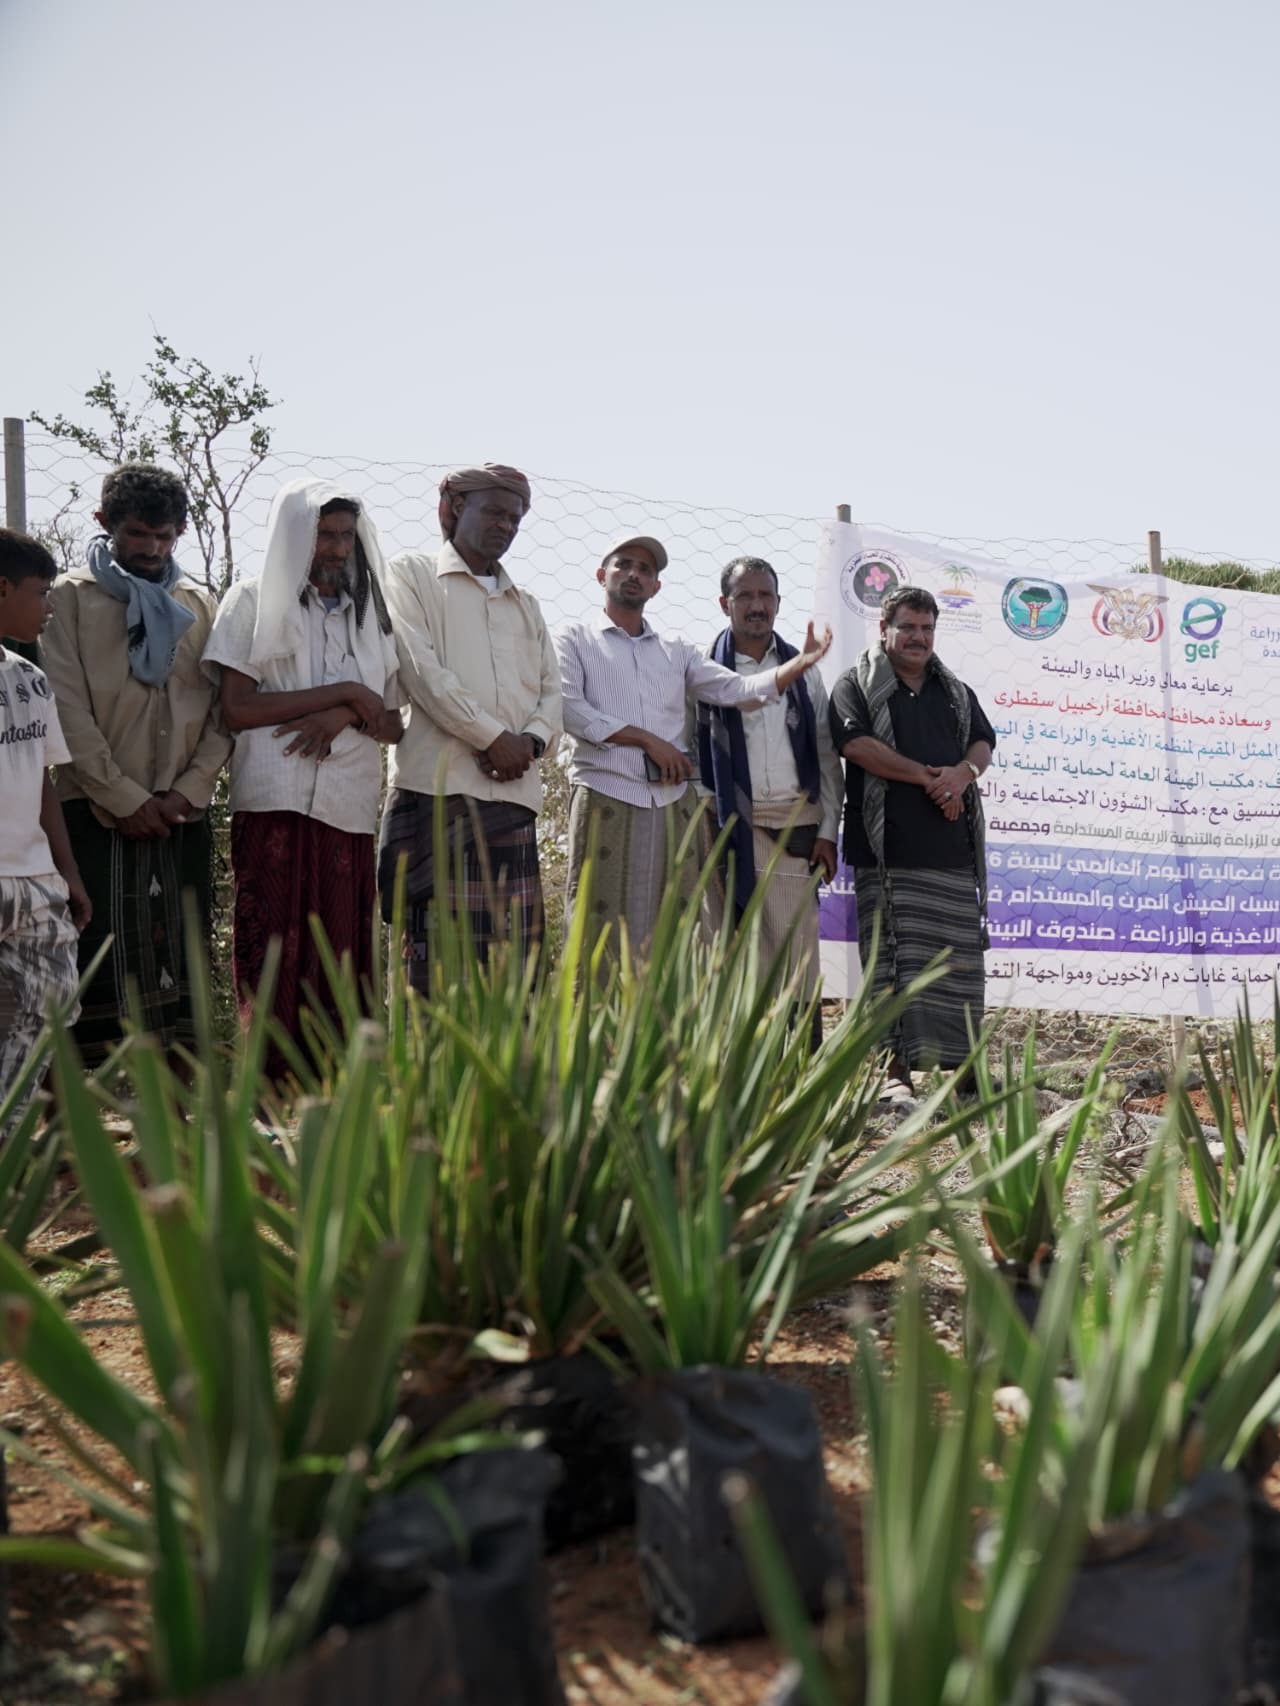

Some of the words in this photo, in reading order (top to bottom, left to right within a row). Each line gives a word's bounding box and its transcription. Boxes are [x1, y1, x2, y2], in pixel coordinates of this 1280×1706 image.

[1184, 640, 1220, 663] gef
[1041, 656, 1092, 680] والبيئة
[1095, 663, 1125, 682] المياه
[1128, 668, 1156, 686] وزير
[1160, 672, 1187, 692] معالي
[1191, 676, 1233, 697] برعاية
[993, 690, 1055, 708] سقطرى
[1058, 693, 1110, 716] أرخبيل
[1113, 698, 1166, 720] محافظة
[1168, 707, 1215, 725] محافظ
[1219, 711, 1272, 731] وسعادة
[992, 720, 1019, 739] اليم
[1022, 719, 1036, 745] في
[1039, 722, 1097, 747] والزراعة
[1101, 728, 1152, 749] الأغذية
[1154, 735, 1194, 754] لمنظمة
[1197, 739, 1235, 761] المقيم
[1013, 752, 1057, 776] البيئة
[1062, 757, 1115, 779] لحماية
[1119, 762, 1160, 783] العامة
[1164, 768, 1204, 790] الهيئة
[1209, 773, 1255, 792] مكتب
[1012, 783, 1096, 809] الاجتماعية
[1099, 792, 1152, 813] الشؤون
[1155, 800, 1198, 818] مكتب
[989, 816, 1051, 836] وجمعية
[1053, 819, 1122, 840] المستدامة
[1124, 827, 1168, 845] الريفية
[1170, 830, 1221, 849] والتنمية
[1224, 832, 1268, 850] للزراعة
[1007, 851, 1063, 874] للبيئة
[1066, 857, 1142, 877] العالمي
[1145, 862, 1195, 883] اليوم
[1199, 863, 1265, 884] فعالية
[1007, 885, 1115, 910] والمستدام
[1118, 890, 1169, 913] المرن
[1173, 892, 1236, 915] العيش
[1239, 895, 1280, 917] سبل
[1036, 920, 1116, 942] صندوق
[1130, 923, 1207, 946] والزراعة
[1025, 961, 1093, 985] ومواجهة
[1161, 971, 1180, 990] دم
[1183, 966, 1226, 988] غابات
